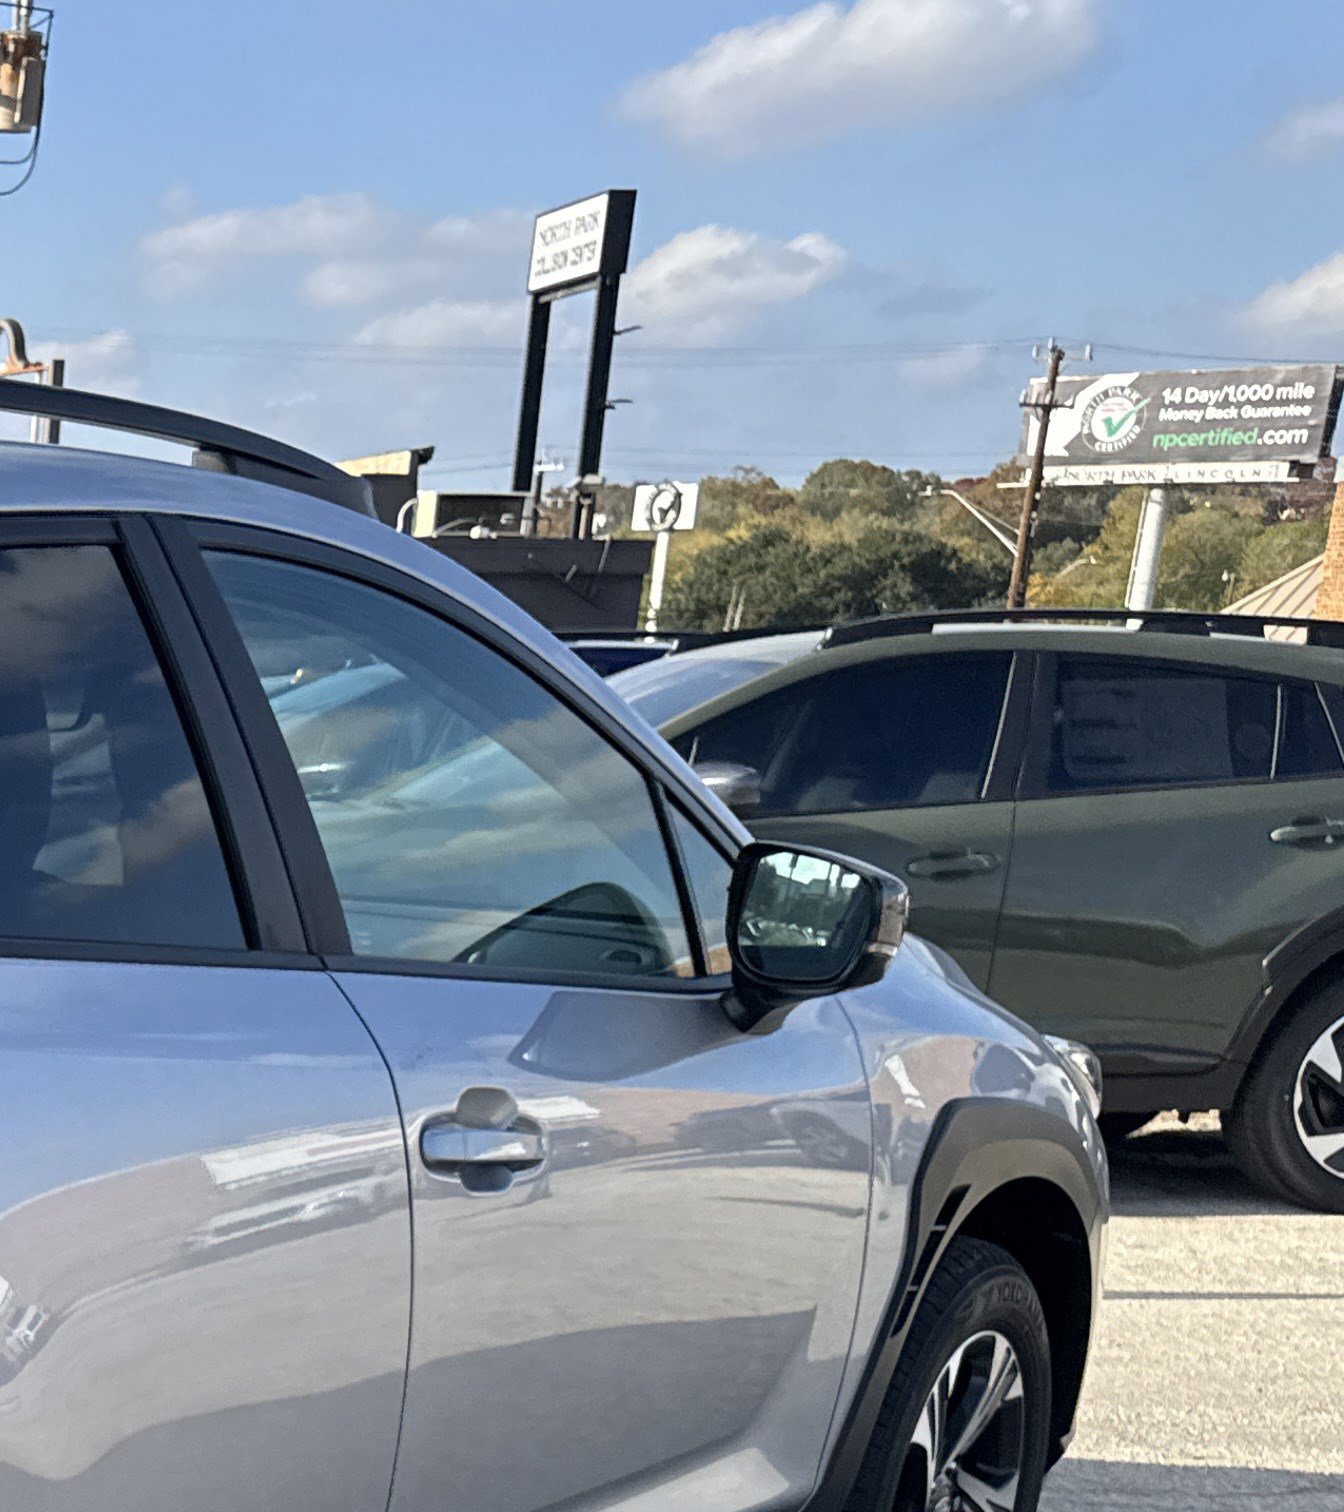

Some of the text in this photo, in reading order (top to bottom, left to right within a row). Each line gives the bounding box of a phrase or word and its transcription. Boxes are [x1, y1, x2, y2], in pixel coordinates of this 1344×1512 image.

[1162, 387, 1182, 405] 14
[1275, 382, 1315, 401] mile
[1158, 404, 1312, 423] Money Back Guarantee
[1152, 427, 1309, 451] npcertified.com
